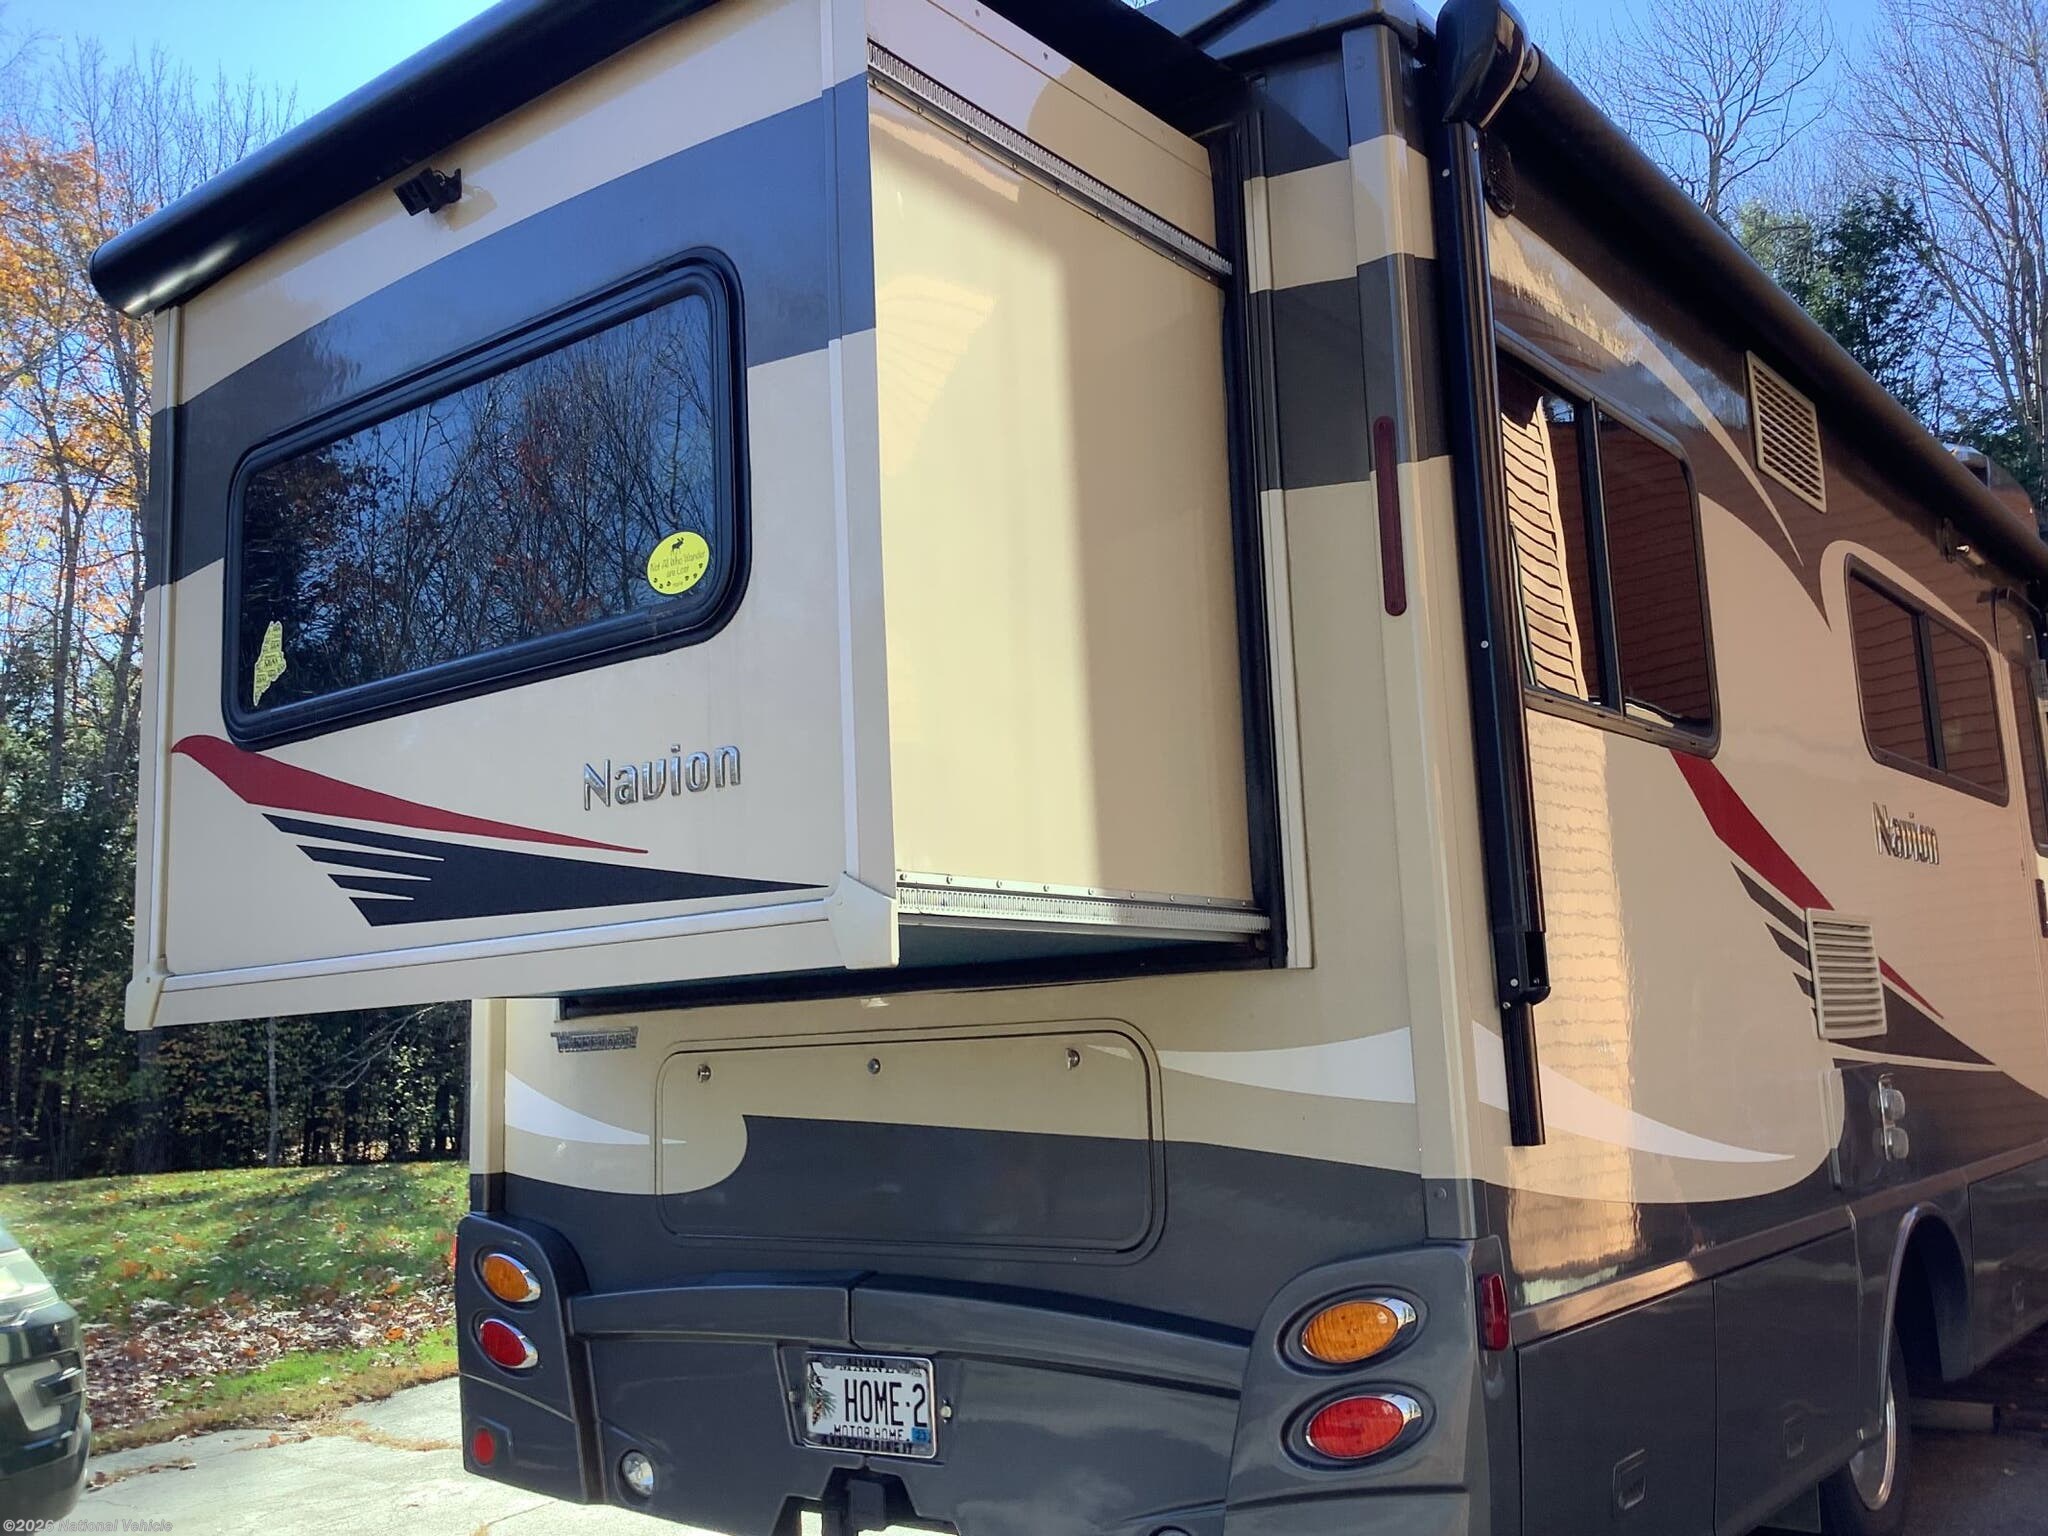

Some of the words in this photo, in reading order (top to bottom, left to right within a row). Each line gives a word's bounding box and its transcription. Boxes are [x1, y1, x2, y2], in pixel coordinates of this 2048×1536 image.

[583, 744, 741, 811] Navion
[1872, 801, 1940, 865] Navion
[834, 1424, 870, 1437] MOTOR
